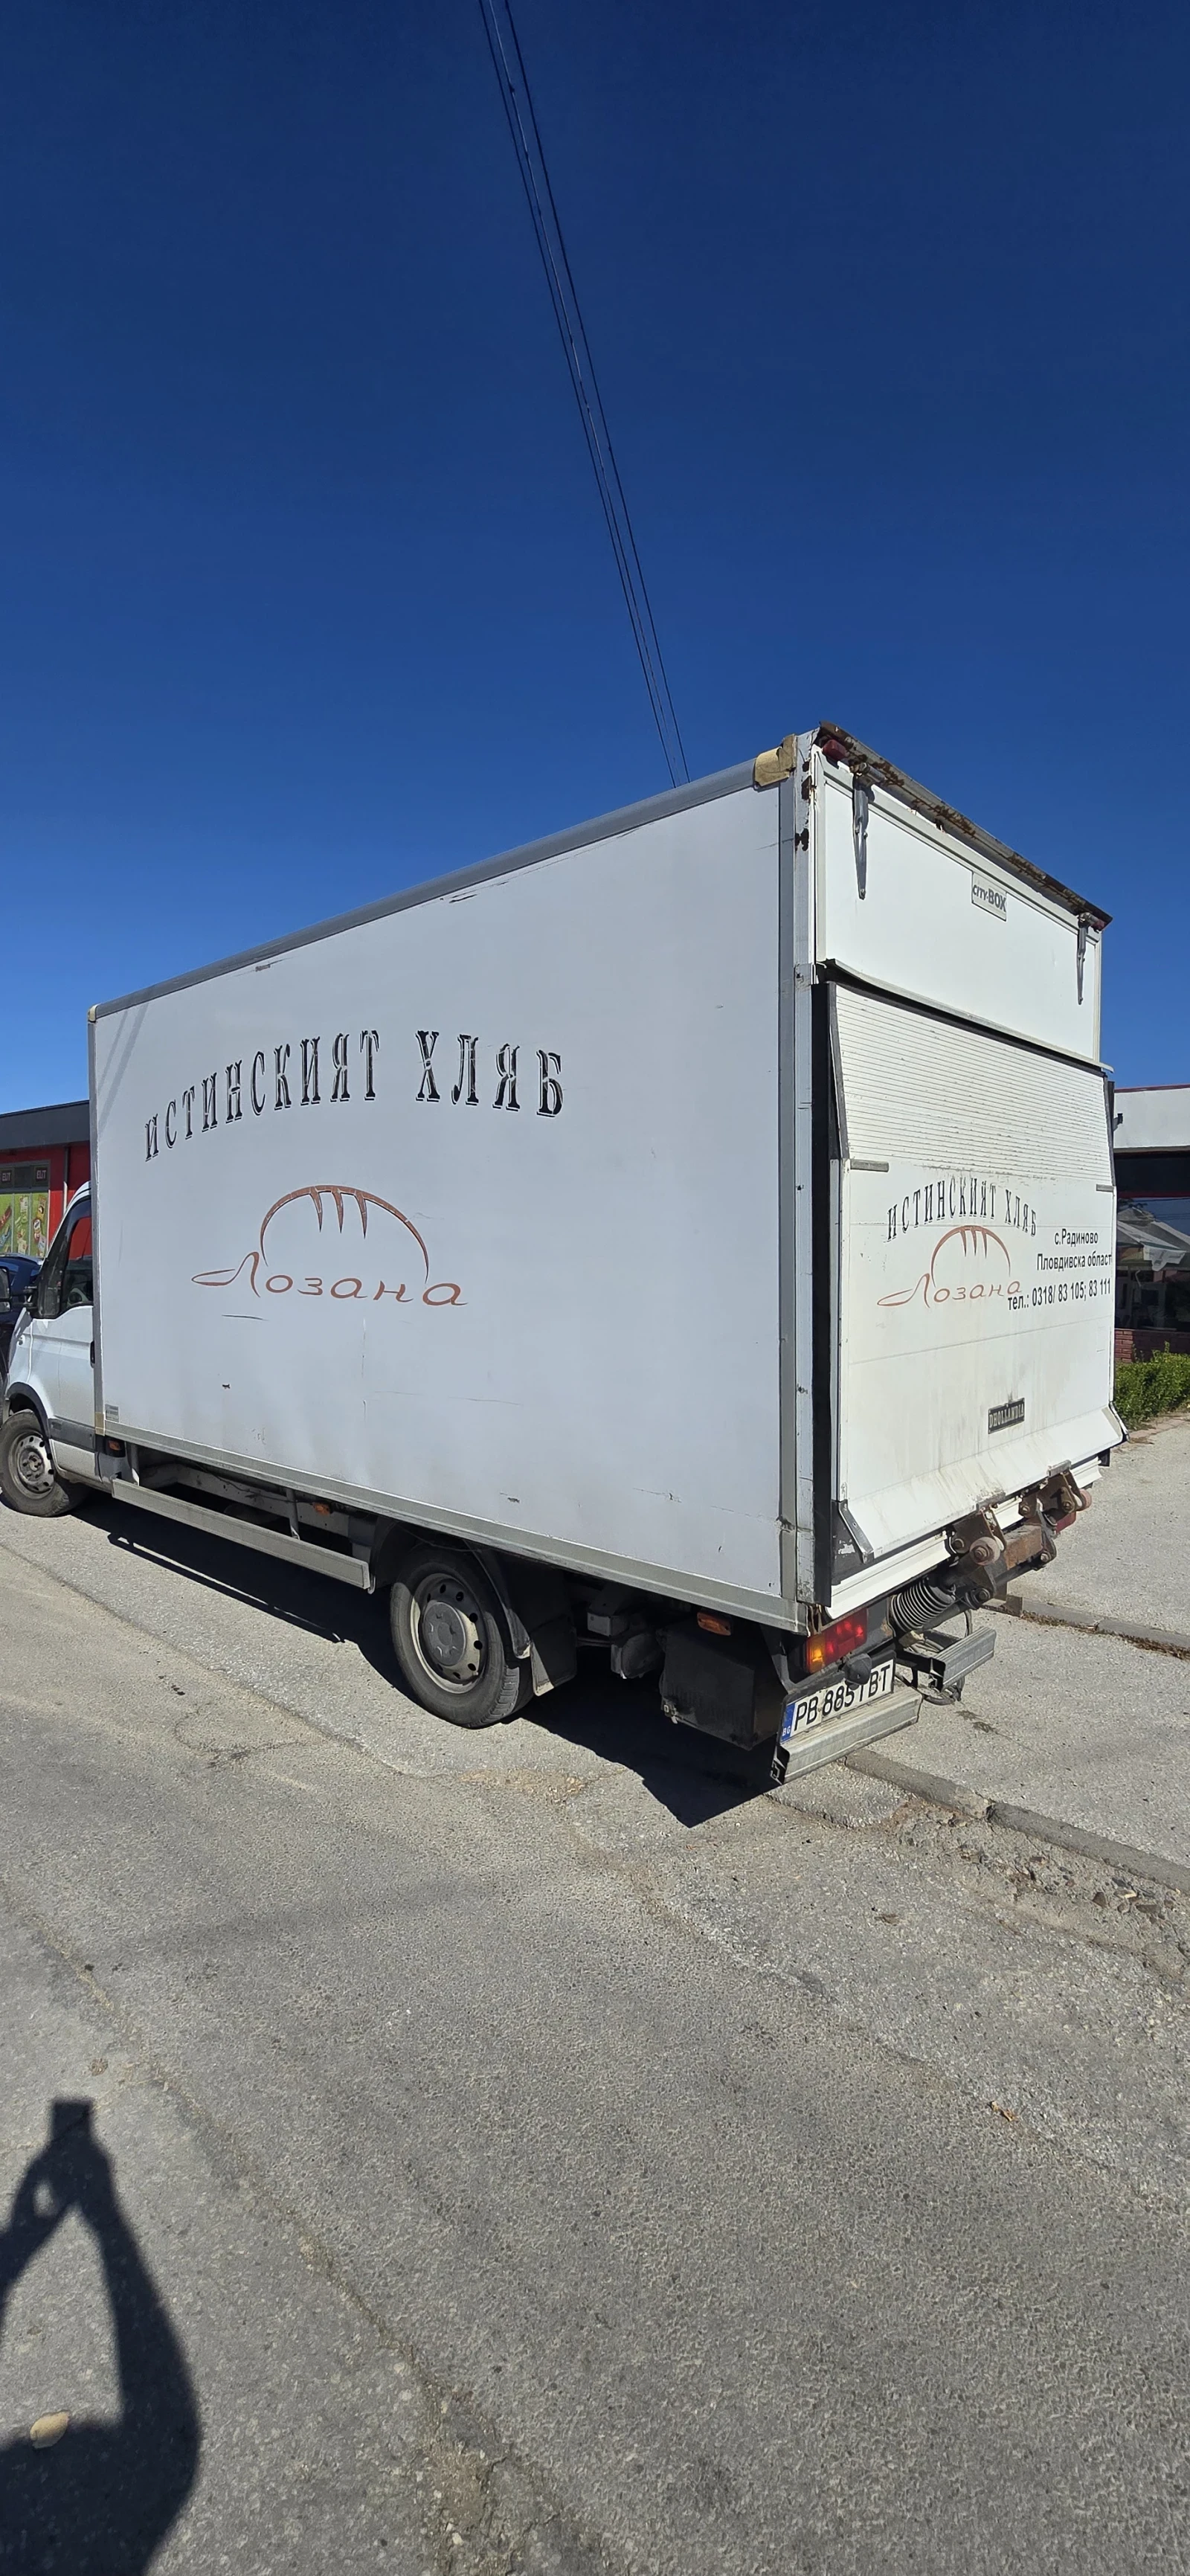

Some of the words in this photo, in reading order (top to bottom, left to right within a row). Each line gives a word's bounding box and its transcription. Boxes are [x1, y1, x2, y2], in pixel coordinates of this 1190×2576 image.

[145, 1030, 379, 1162] ИСТИНСКИЯТ
[416, 1030, 565, 1118] ХЛЯБ
[886, 1177, 996, 1243] ИСТИНСКИЯТ
[1005, 1189, 1037, 1237] ХЛЯБ
[1037, 1253, 1086, 1272] Пловдивска
[1087, 1250, 1112, 1267] област
[191, 1252, 469, 1307] Лозана
[877, 1272, 1023, 1308] Лозана
[1032, 1285, 1056, 1307] 0318/
[1058, 1283, 1067, 1303] 83
[1070, 1281, 1087, 1302] 105;
[1089, 1279, 1098, 1297] 83
[1100, 1277, 1110, 1295] 111
[782, 1726, 791, 1736] BG
